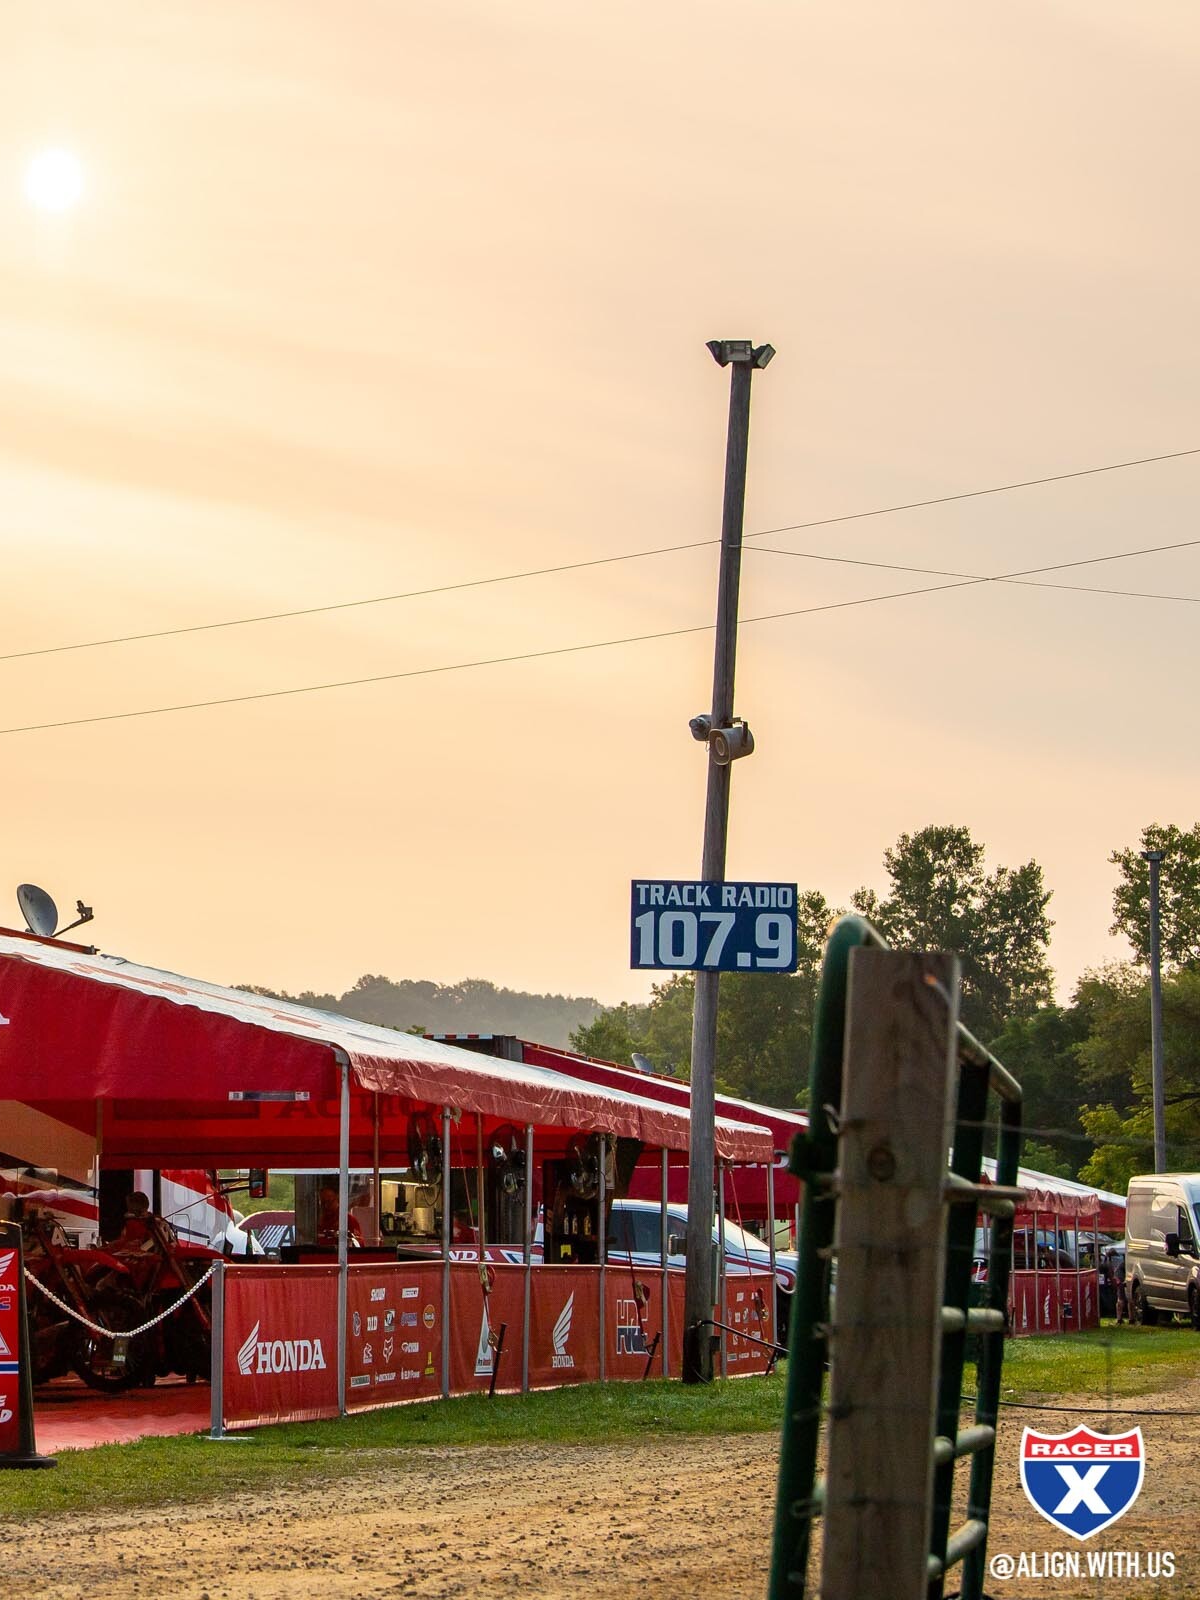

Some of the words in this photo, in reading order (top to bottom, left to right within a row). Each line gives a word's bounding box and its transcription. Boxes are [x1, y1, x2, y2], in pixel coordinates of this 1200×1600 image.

[636, 884, 712, 907] TRACK
[721, 886, 793, 909] RADIO
[635, 910, 793, 968] 107.9
[256, 1338, 327, 1374] HONDA
[552, 1355, 575, 1369] HONDA
